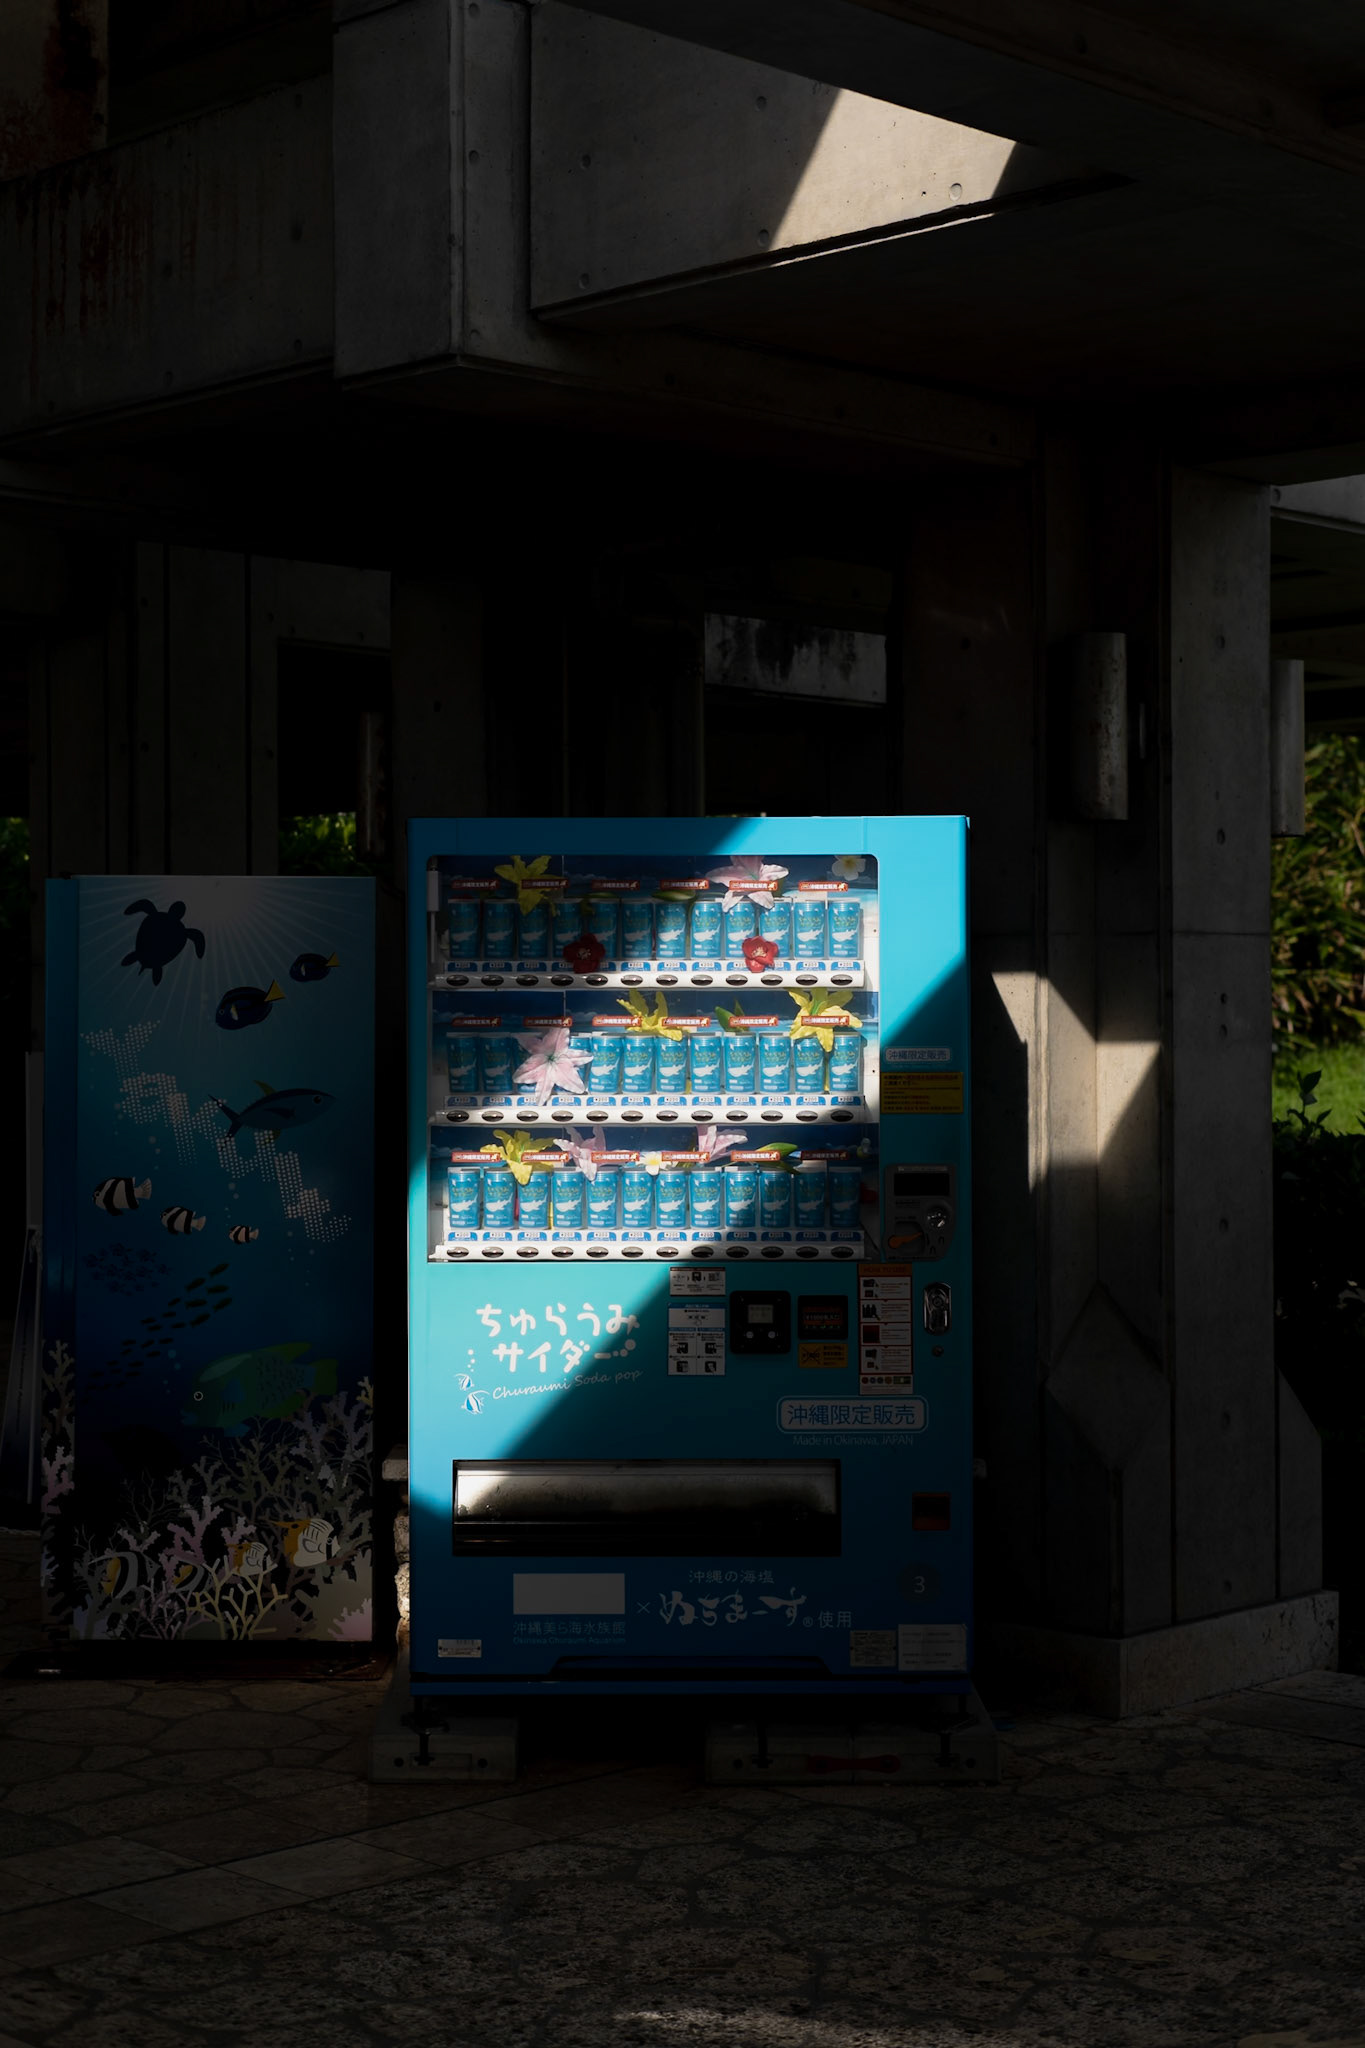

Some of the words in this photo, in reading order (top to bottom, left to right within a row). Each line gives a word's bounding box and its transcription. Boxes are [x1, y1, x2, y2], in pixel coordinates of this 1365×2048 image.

[476, 1303, 640, 1337] ちゅらうみ
[492, 1338, 636, 1374] サイダー
[492, 1377, 573, 1400] Churaumi
[574, 1370, 611, 1387] Soda
[614, 1369, 644, 1385] pop
[788, 1404, 916, 1425] 沖縄限定販売
[793, 1435, 822, 1446] Made
[823, 1435, 832, 1446] in
[881, 1435, 914, 1446] JAPAN
[688, 1569, 775, 1584] 沖縄の海塩
[911, 1575, 927, 1593] 3
[513, 1621, 626, 1636] 沖縄美ら海水族館
